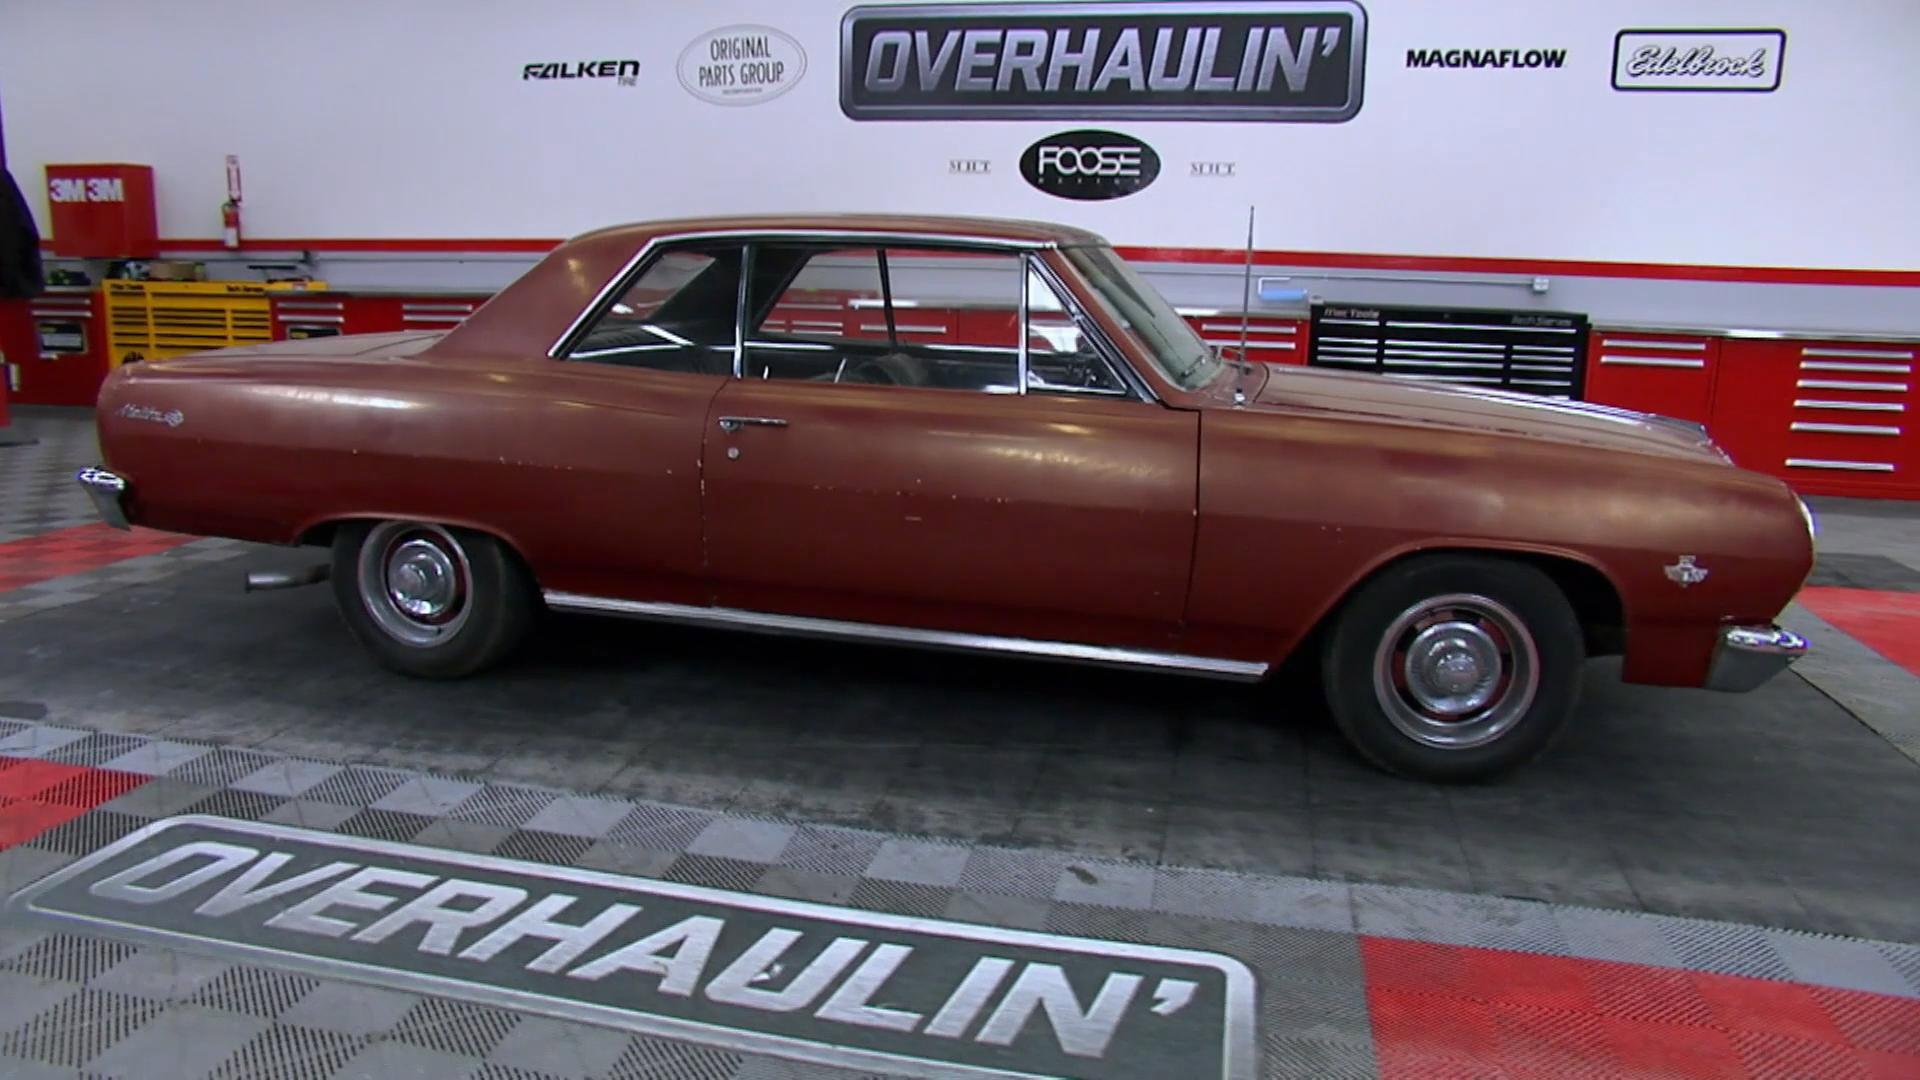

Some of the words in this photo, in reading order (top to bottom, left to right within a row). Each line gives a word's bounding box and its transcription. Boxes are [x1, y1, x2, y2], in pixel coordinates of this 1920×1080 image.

[710, 36, 771, 61] ORIGINAL
[864, 26, 1342, 92] OVERHAULIN'
[1406, 49, 1567, 68] MAGNAFLOW
[1626, 44, 1767, 78] Edelbrock
[523, 60, 640, 80] FALKEN
[699, 65, 735, 87] PARTS
[740, 61, 784, 86] GROUP
[1038, 146, 1142, 176] FOOSE
[50, 178, 85, 202] 3M
[87, 178, 124, 202] 3M
[89, 840, 1198, 1058] OVERHAULIN'
